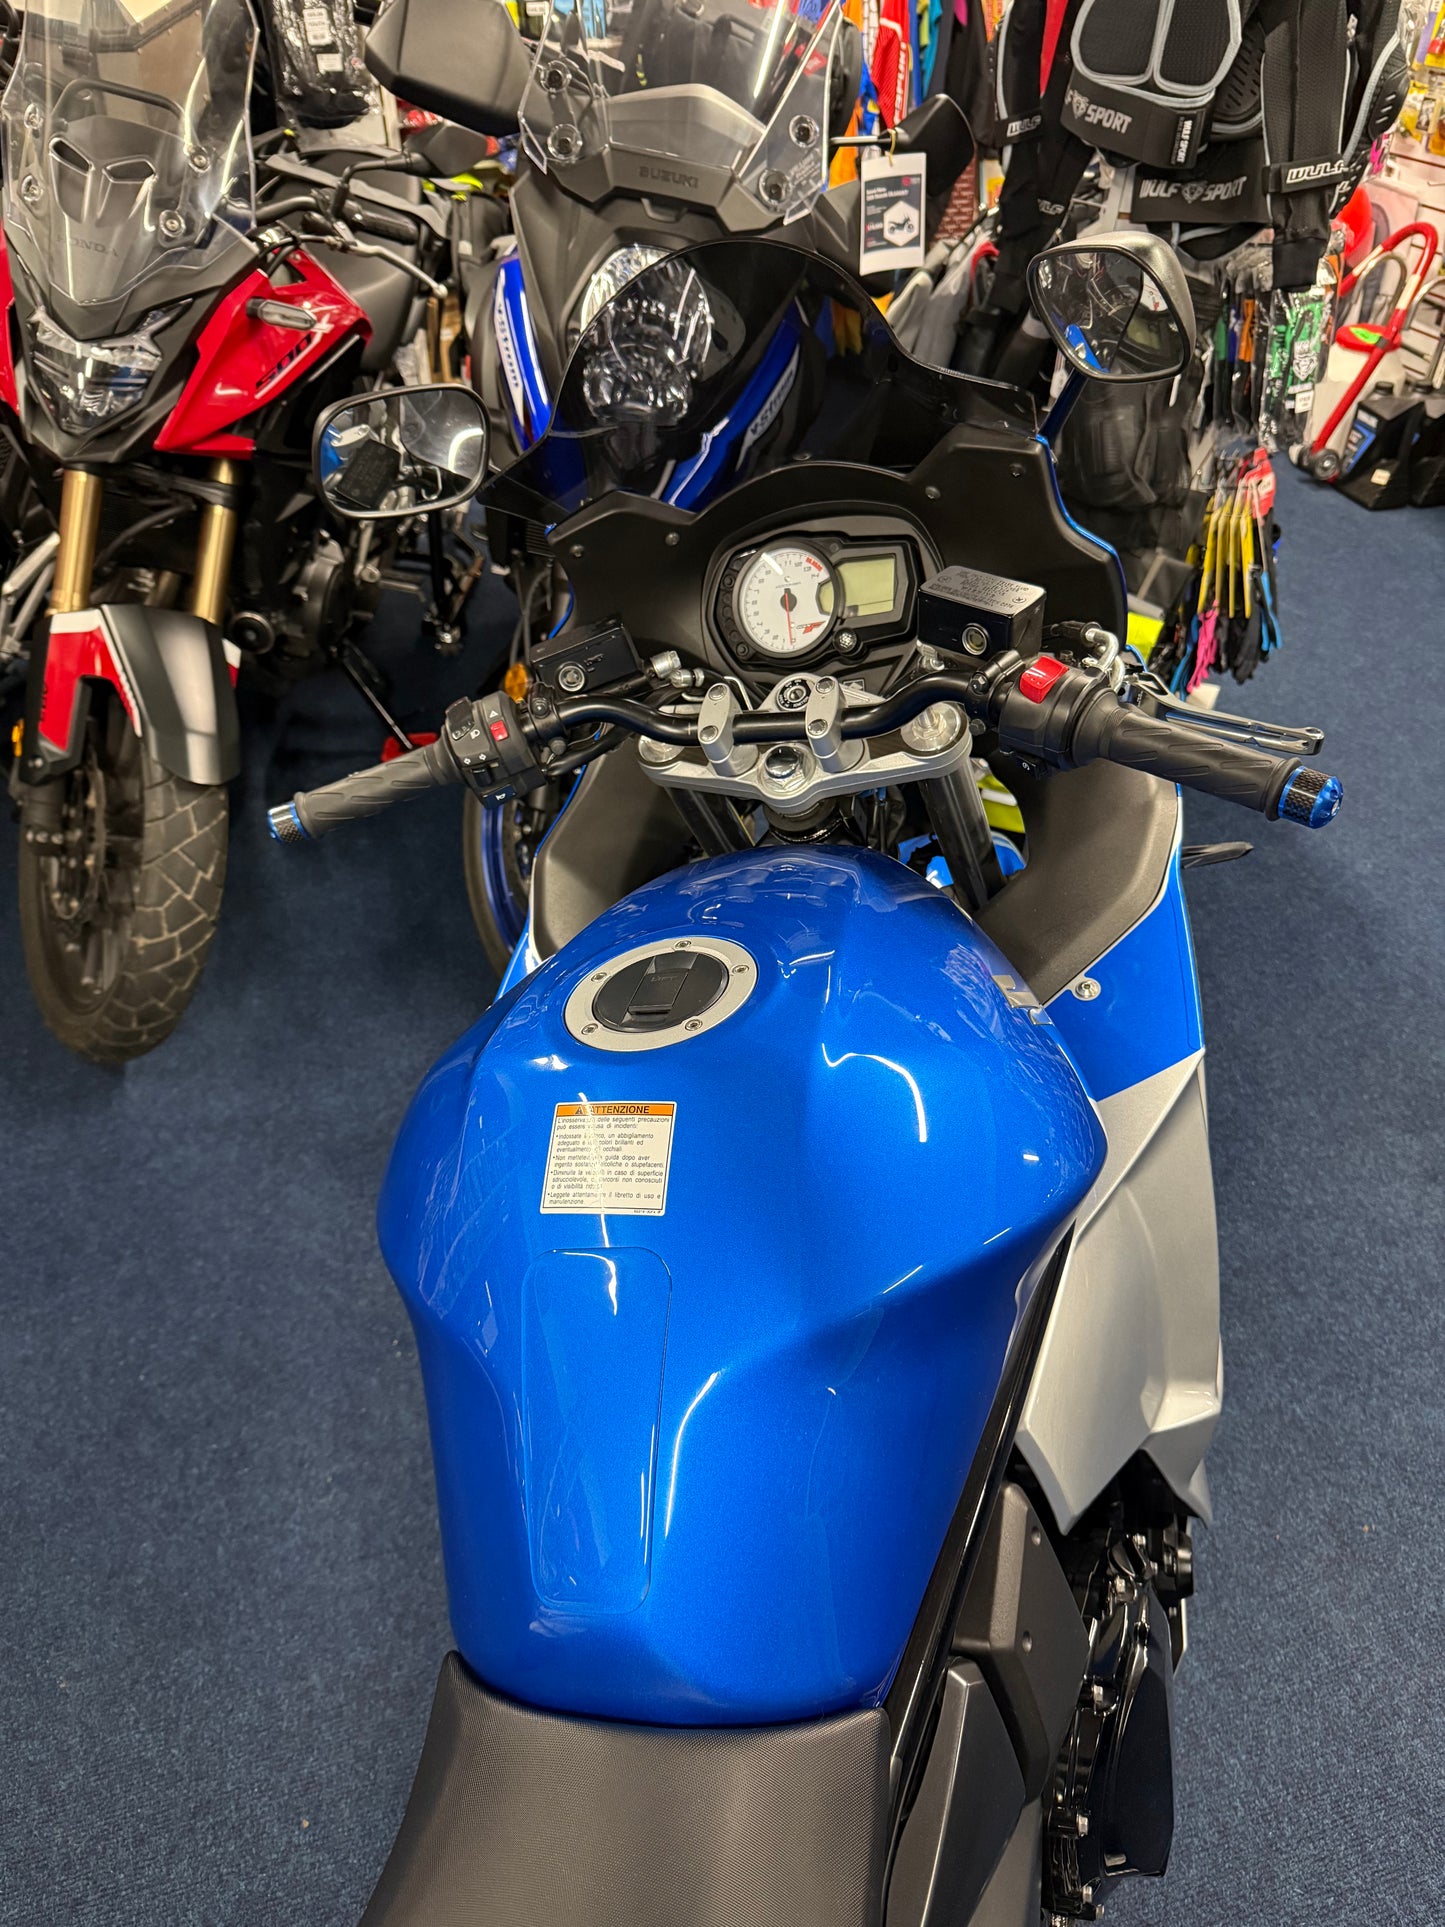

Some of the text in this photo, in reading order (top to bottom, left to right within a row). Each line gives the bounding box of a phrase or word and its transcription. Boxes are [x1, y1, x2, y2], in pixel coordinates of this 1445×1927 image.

[1084, 103, 1133, 134] SPORT
[638, 165, 699, 189] SUZUKI
[1139, 176, 1247, 202] WULF SPORT
[590, 1105, 650, 1114] ATTENZIONE
[612, 1116, 635, 1124] seguenti
